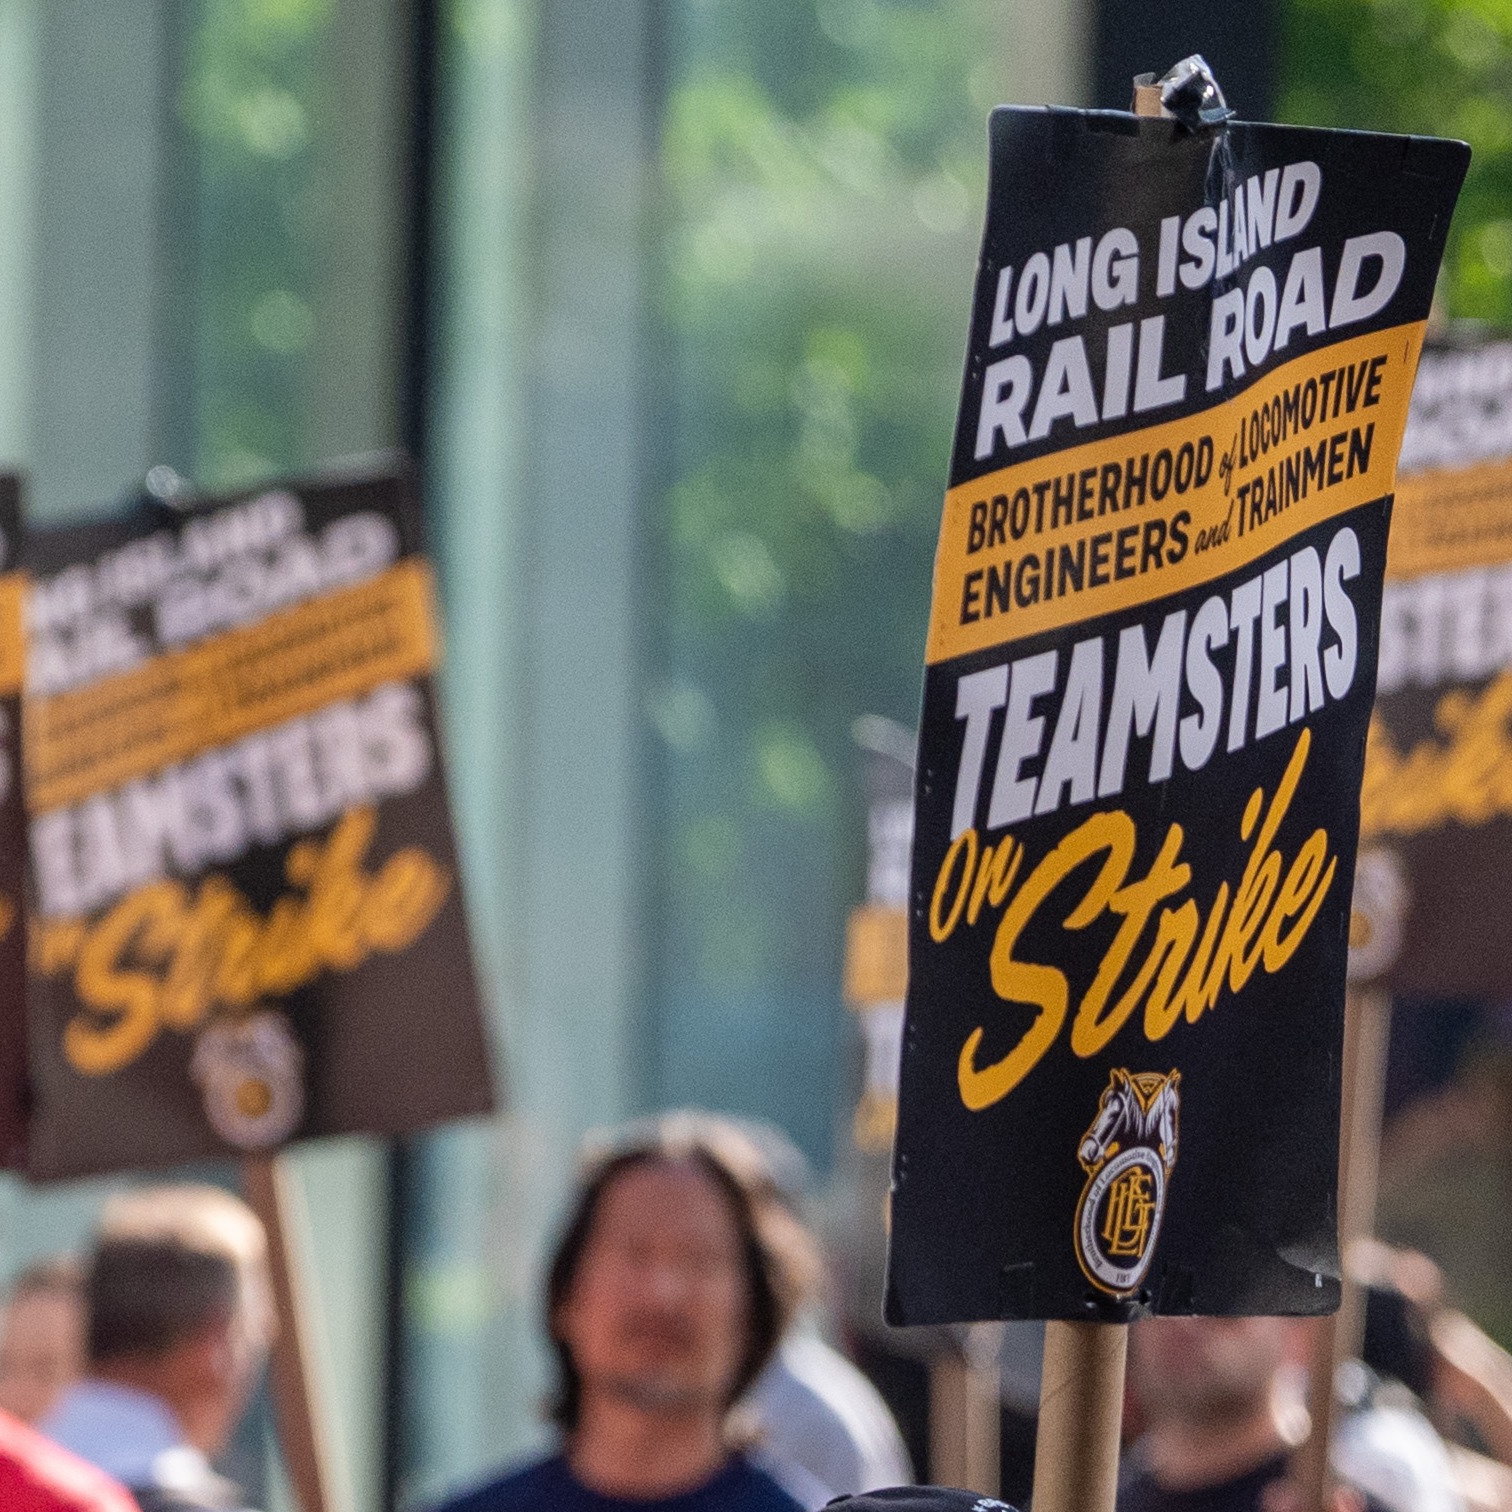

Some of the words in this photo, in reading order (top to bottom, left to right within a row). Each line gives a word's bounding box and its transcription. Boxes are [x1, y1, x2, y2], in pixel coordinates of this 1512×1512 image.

[975, 315, 1187, 460] RAIL
[1205, 231, 1406, 393] ROAD
[990, 228, 1139, 349] LONG
[1156, 161, 1321, 297] ISLAND
[959, 510, 1191, 626] ENGINEERS
[1194, 507, 1232, 554] and
[1237, 423, 1375, 537] TRAINMEN
[967, 435, 1213, 555] BROTHERHOOD
[1219, 433, 1239, 491] of
[1238, 355, 1387, 467] LOCOMOTIVE
[950, 526, 1361, 841] TEAMSTERS
[29, 683, 432, 919] EAMSTERS
[928, 829, 1023, 942] On
[64, 803, 454, 1075] Strike
[957, 727, 1337, 1110] Strike
